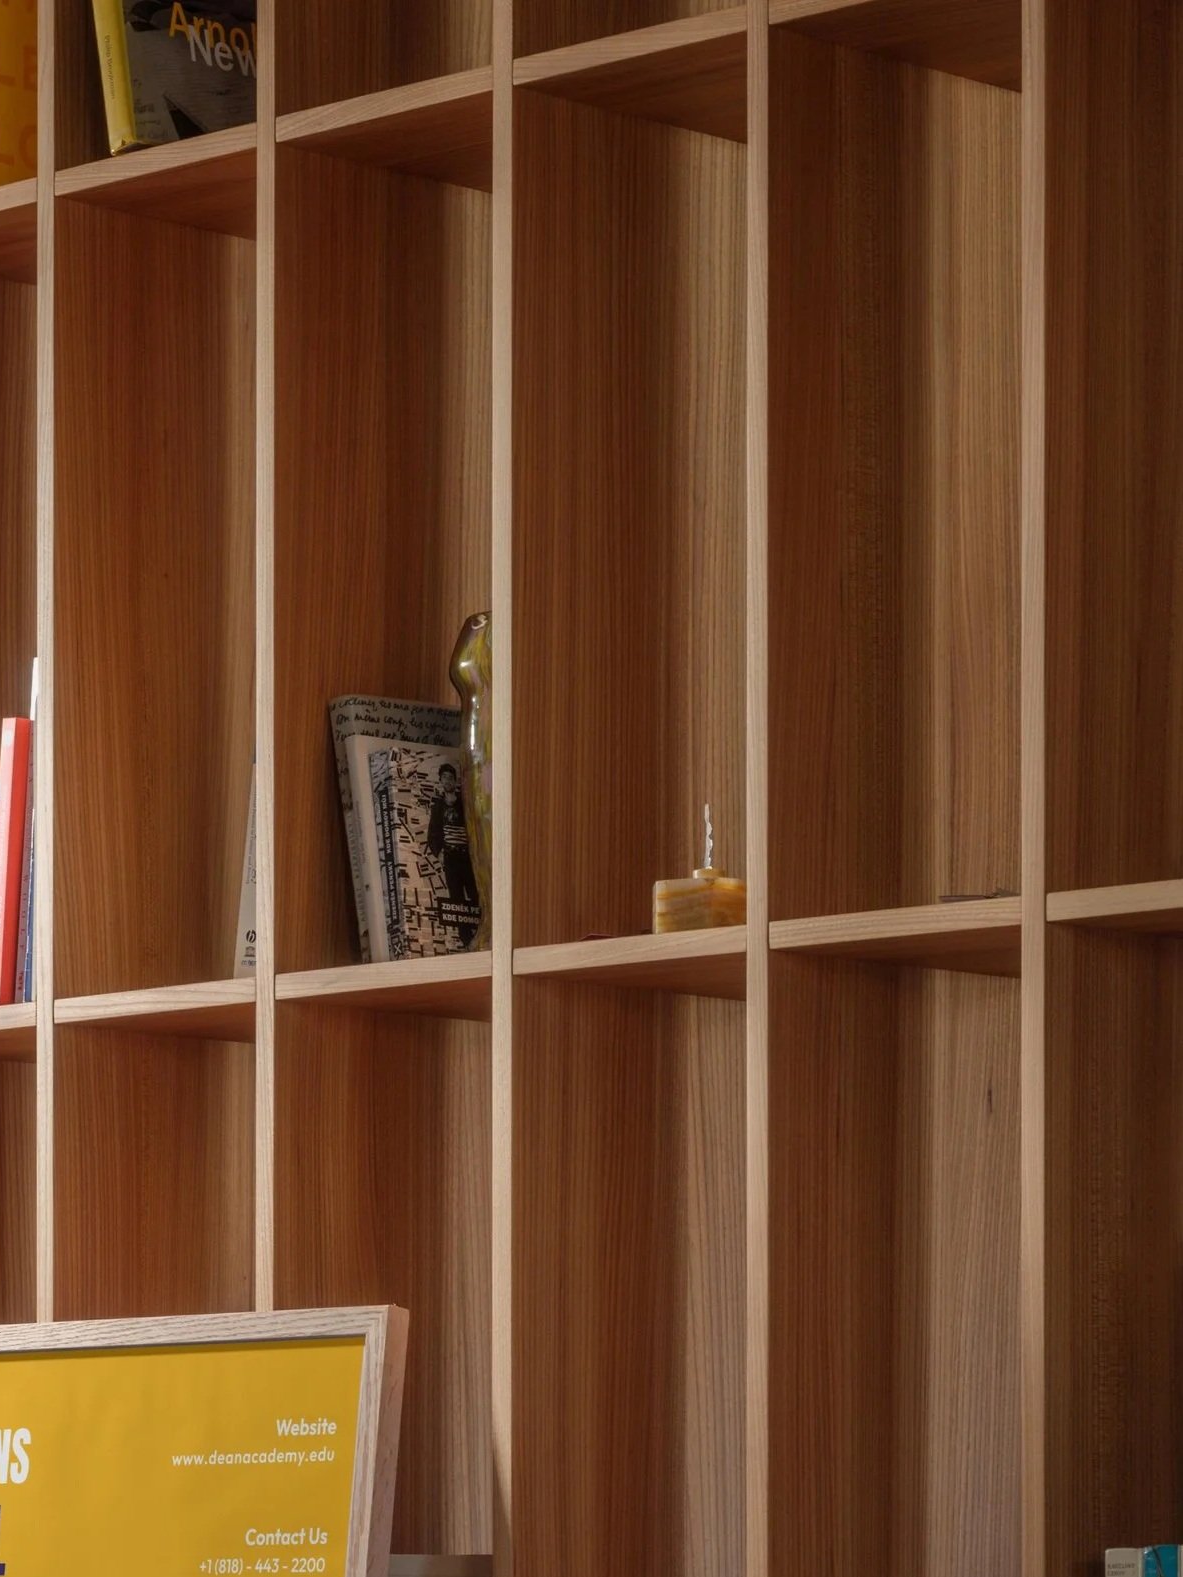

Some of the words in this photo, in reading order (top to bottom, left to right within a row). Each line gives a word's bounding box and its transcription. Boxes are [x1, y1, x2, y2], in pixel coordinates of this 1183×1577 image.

[442, 913, 457, 922] KDE
[276, 1419, 337, 1438] Website
[172, 1447, 335, 1469] www.deanacademy.edu
[245, 1528, 293, 1546] Contact
[296, 1528, 328, 1545] Us
[255, 1558, 280, 1574] 443
[291, 1557, 325, 1574] 2200
